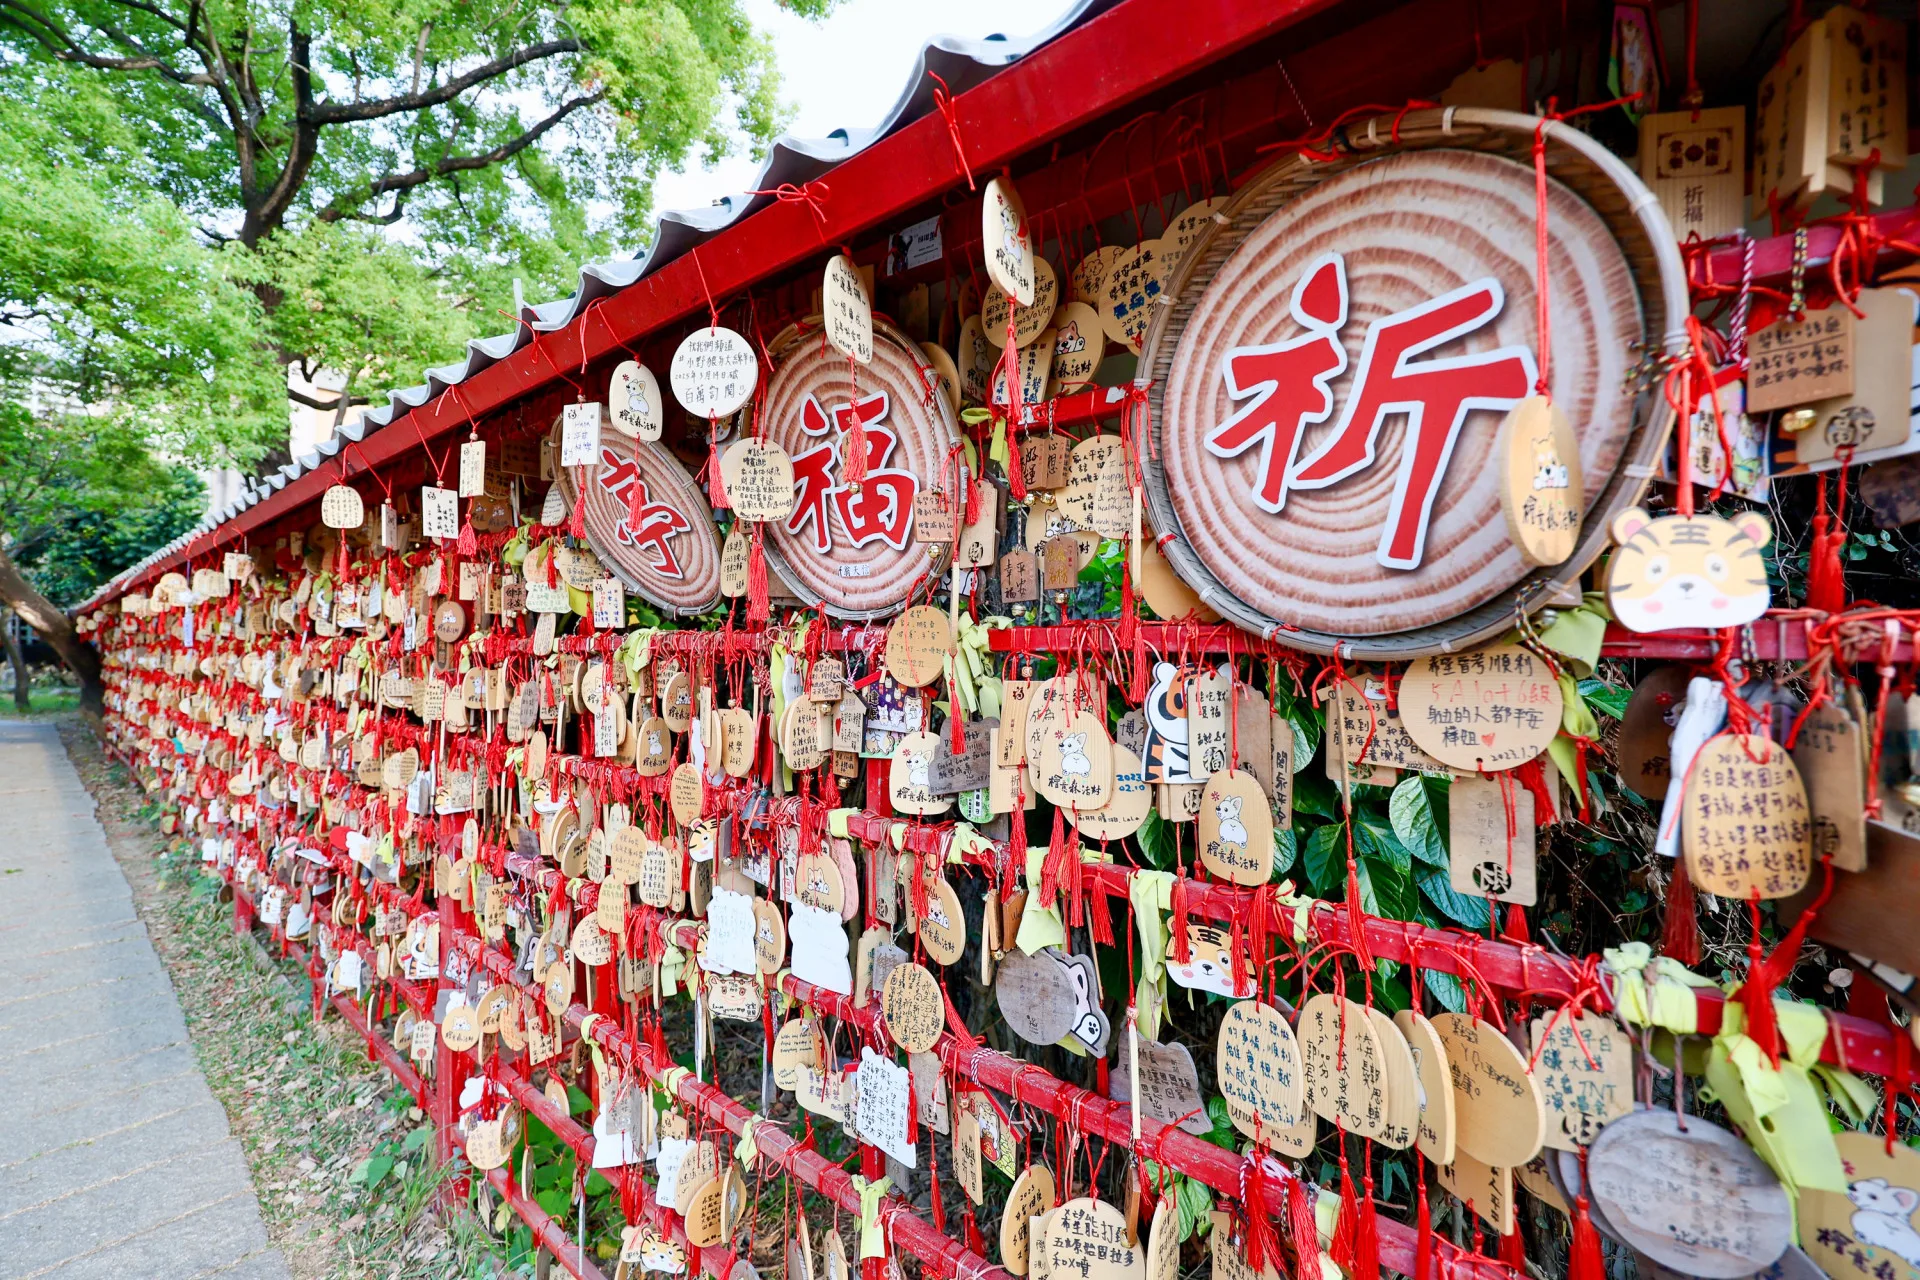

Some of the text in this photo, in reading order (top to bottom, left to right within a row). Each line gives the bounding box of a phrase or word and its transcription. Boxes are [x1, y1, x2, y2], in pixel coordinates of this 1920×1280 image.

[1683, 185, 1703, 223] 祈福
[1205, 253, 1537, 569] 祈
[787, 390, 919, 553] 福
[1048, 774, 1101, 796] 檜意森活村
[1116, 773, 1141, 782] 2023
[1119, 784, 1145, 792] 02.10
[1207, 841, 1259, 872] 檜意森活村
